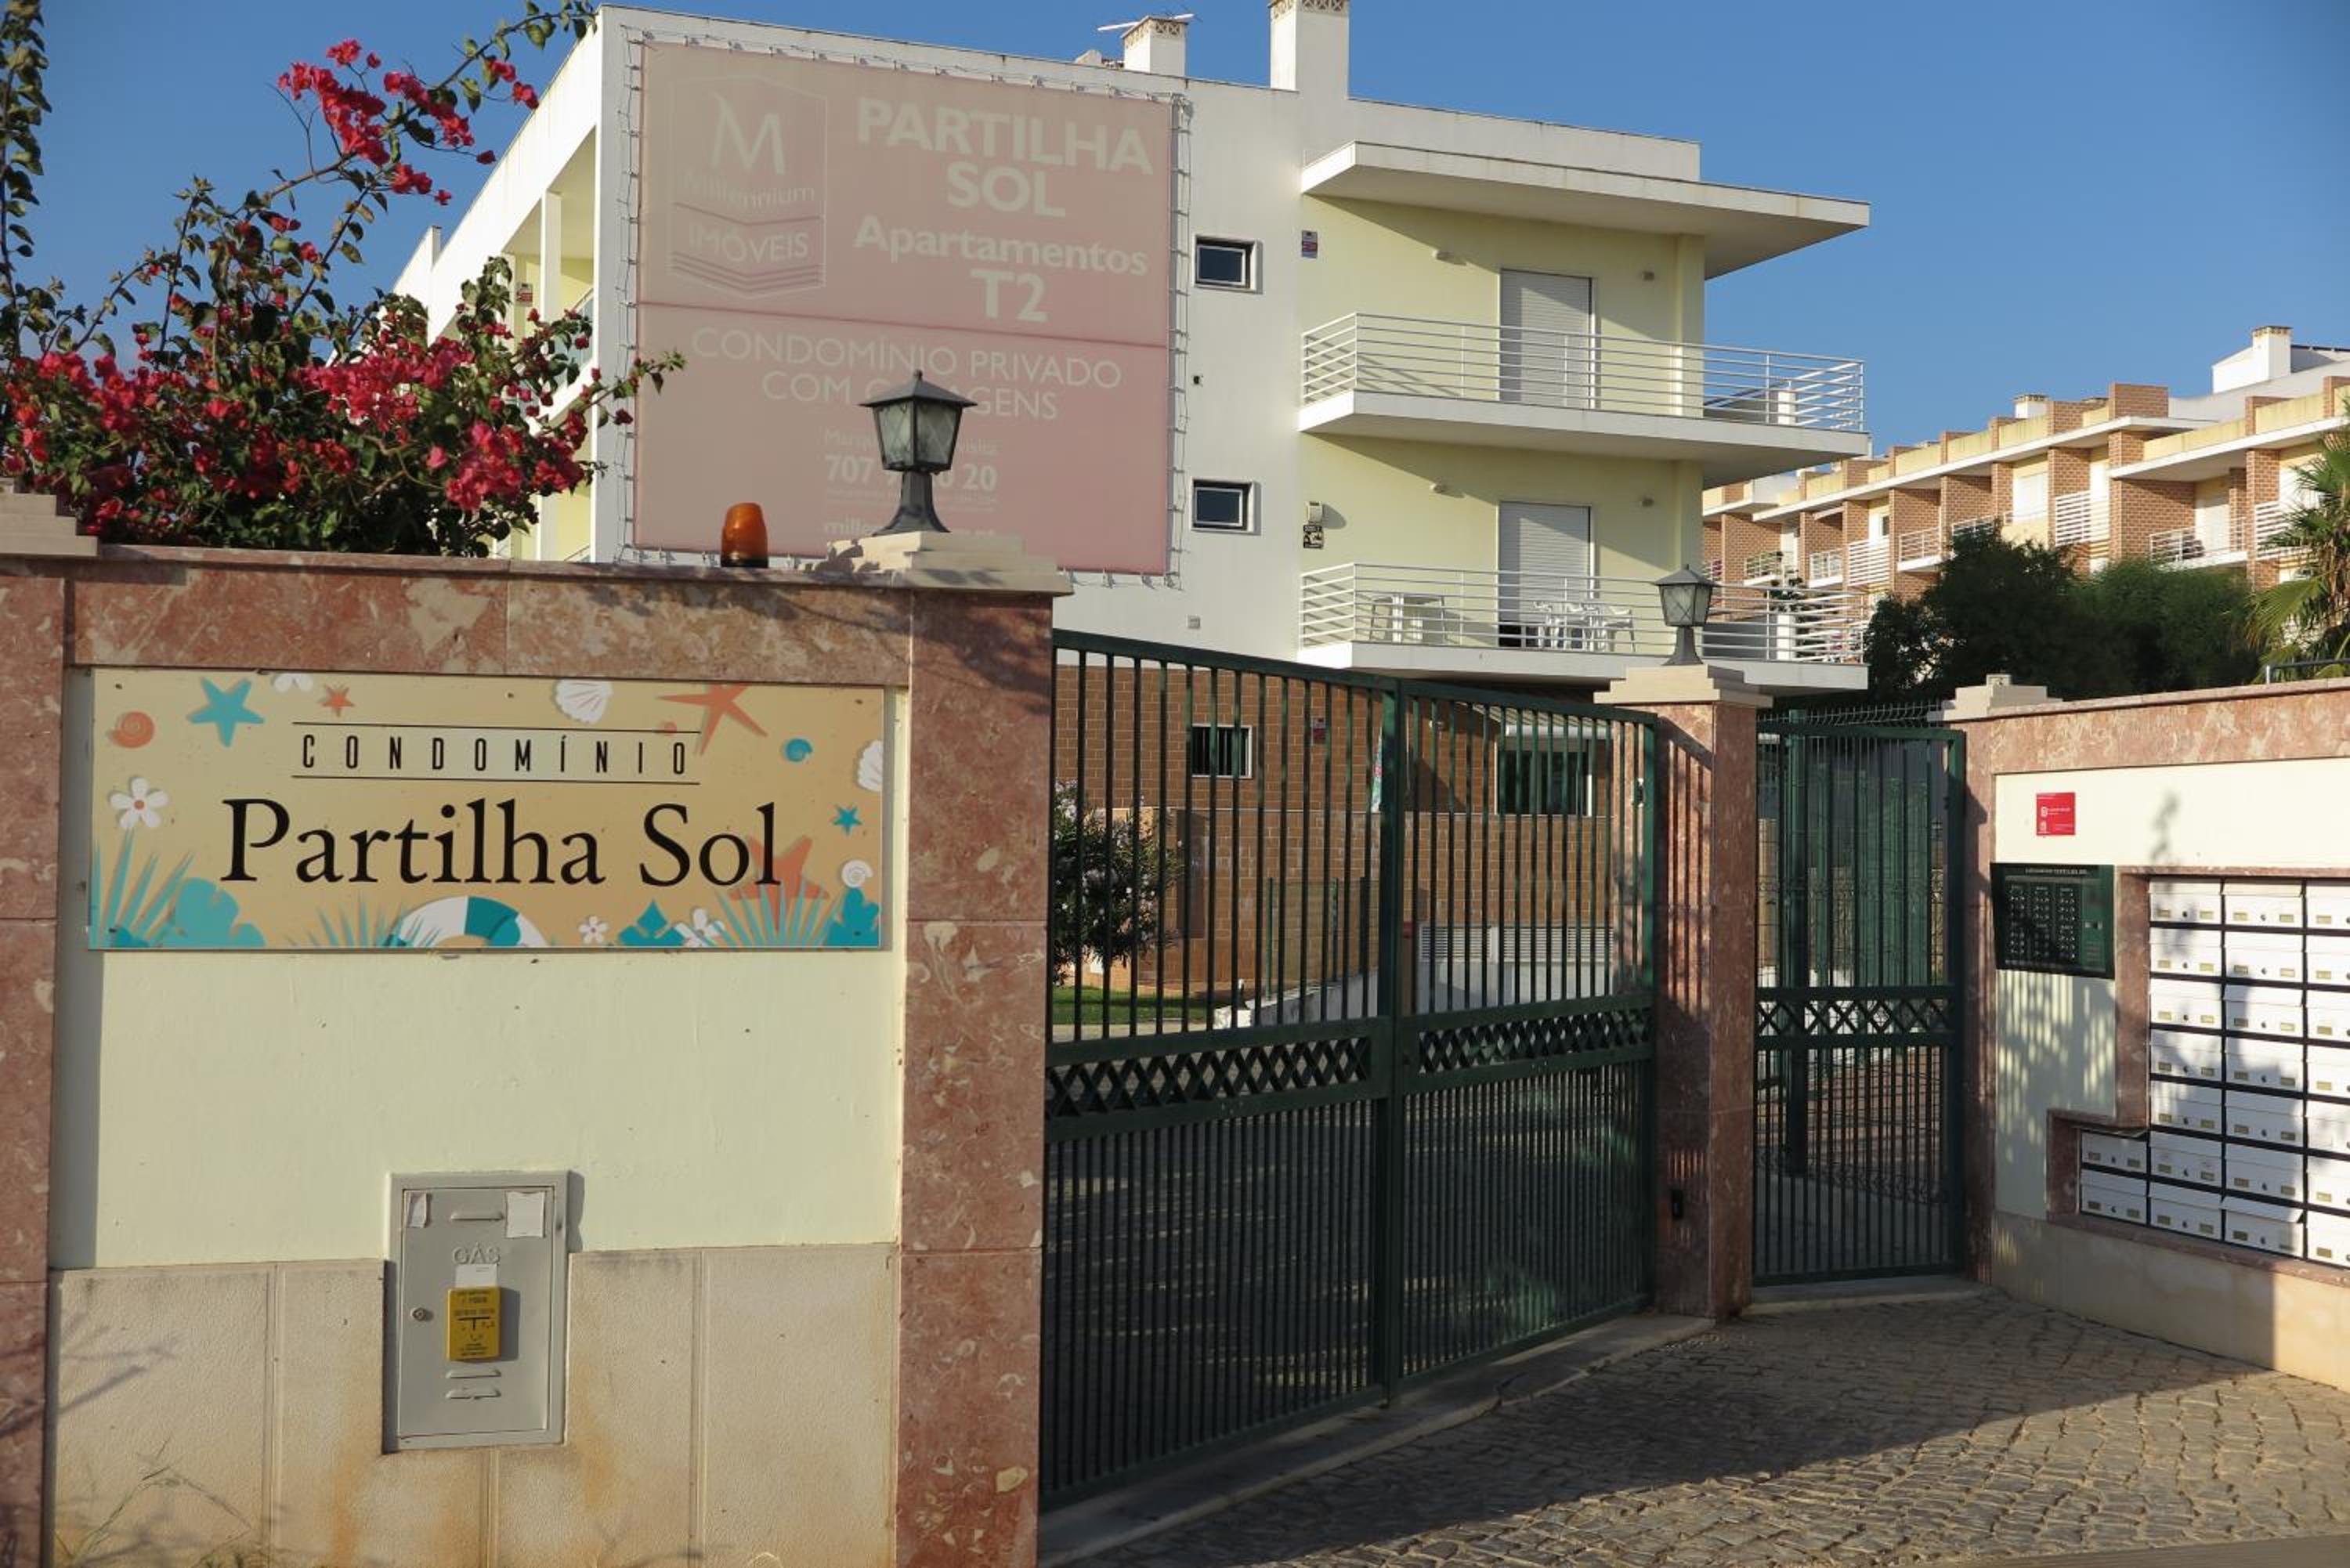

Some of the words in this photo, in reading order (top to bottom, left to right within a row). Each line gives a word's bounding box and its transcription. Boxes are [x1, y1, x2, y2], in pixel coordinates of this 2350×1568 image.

[711, 91, 786, 175] M
[859, 98, 1154, 175] PARTILHA
[947, 164, 1065, 217] SOL
[853, 216, 1148, 276] Apartamentos
[970, 269, 1048, 323] T2
[692, 330, 956, 375] CONDOMÍNIO
[971, 351, 1121, 389] PRIVADO
[762, 370, 851, 403] COM
[826, 453, 873, 484] 707
[963, 464, 997, 491] 20
[302, 733, 687, 775] CONDOMÍNIO
[220, 797, 606, 884] Partilha
[639, 803, 781, 886] Sol
